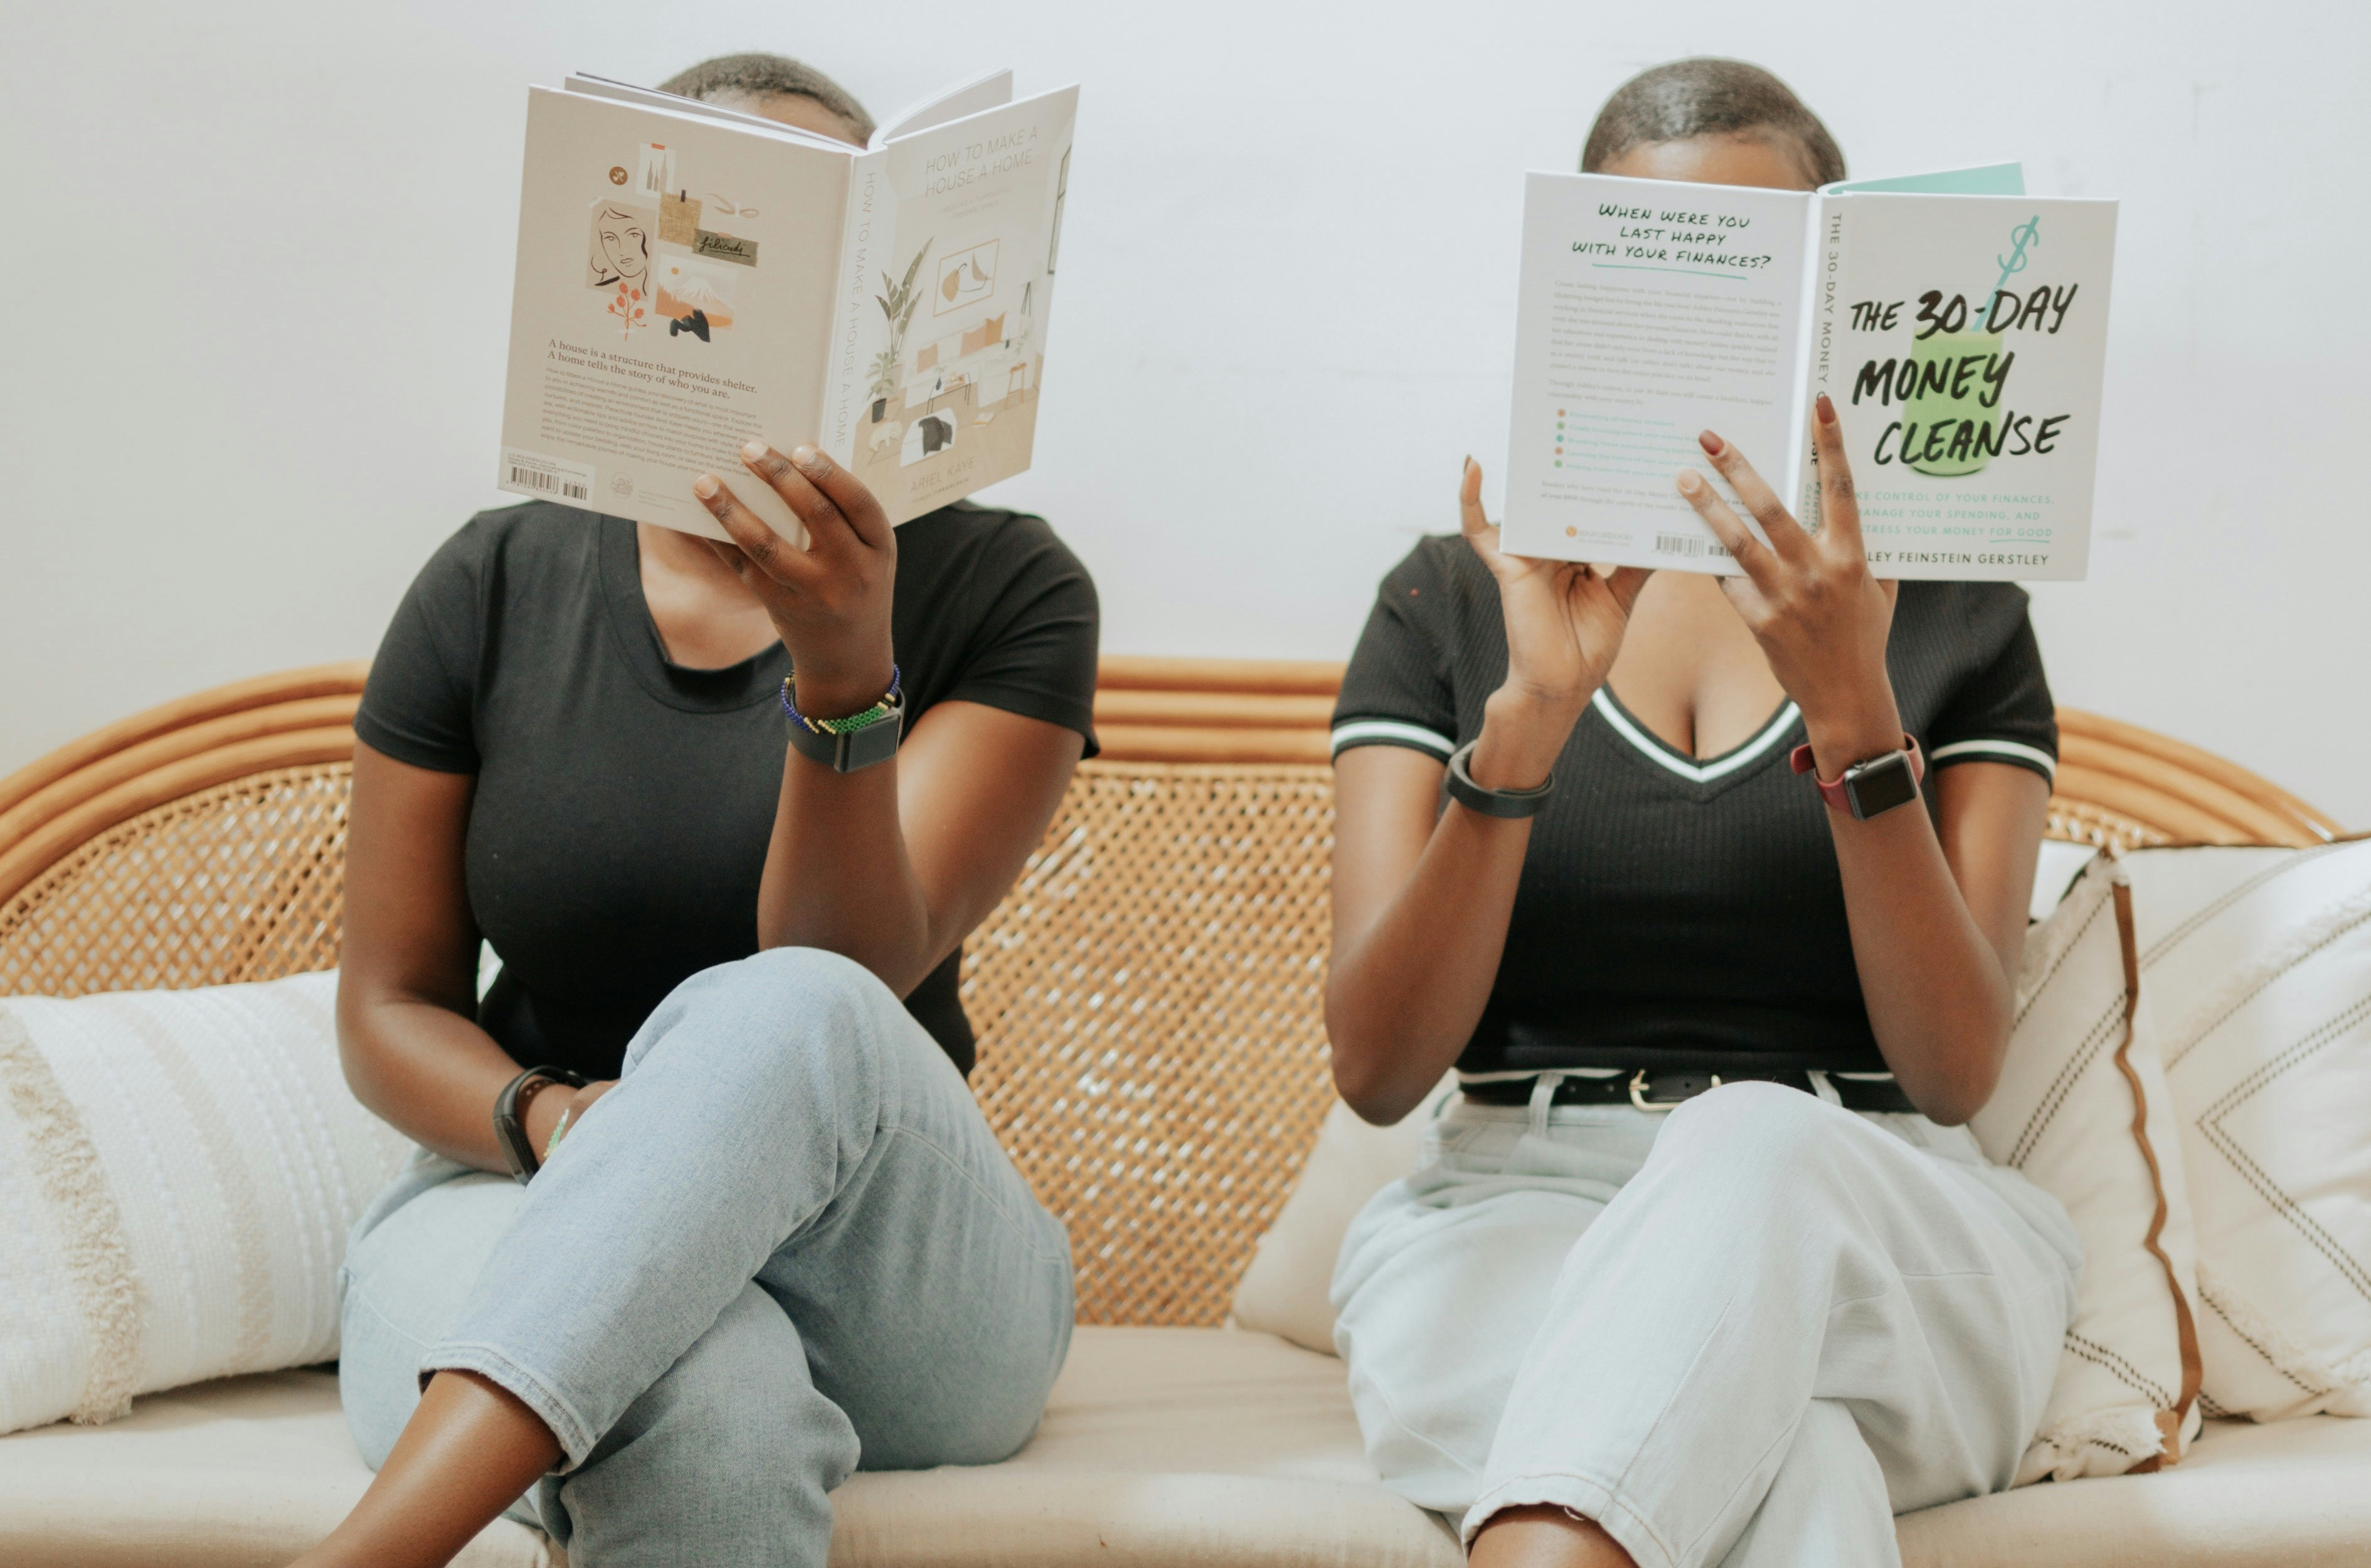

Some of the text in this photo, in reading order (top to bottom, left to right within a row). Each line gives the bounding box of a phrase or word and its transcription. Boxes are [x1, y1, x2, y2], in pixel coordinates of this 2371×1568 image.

[926, 125, 1037, 175] HOW TO MAKE A
[926, 149, 1033, 198] HOUSE A HOME
[1598, 203, 1751, 230] WHEN WERE YOU
[1829, 213, 1842, 245] THE
[1620, 226, 1726, 246] LAST HAPPY
[1572, 242, 1772, 269] WITH YOUR FINANCES?
[1824, 252, 1838, 315] 30-DAY
[834, 172, 876, 448] HOW TO MAKE A HOUSE A HOME
[1850, 300, 1906, 332] THE
[548, 338, 556, 347] A
[560, 340, 587, 354] house
[608, 351, 654, 369] structure
[656, 362, 675, 374] that
[678, 367, 719, 386] provides
[722, 377, 757, 393] shelter.
[1818, 322, 1832, 383] MONEY
[548, 349, 729, 398] A home tells the story of who you are.
[1852, 351, 2015, 408] MONEY
[1874, 411, 2071, 465] CLEANSE
[911, 457, 975, 493] ARIEL KAYE
[1856, 492, 2055, 505] KE CONTROL OF YOUR FINANCES,
[1911, 510, 1941, 519] YOUR
[1947, 511, 2010, 521] SPENDING,
[2015, 512, 2040, 520] AND
[1907, 526, 1938, 535] YOUR
[1943, 527, 1985, 536] MONEY
[1990, 528, 2013, 537] FOR
[2018, 528, 2052, 538] GOOD
[1899, 553, 1972, 563] FEINSTEIN
[1978, 554, 2049, 565] GERSTLEY
